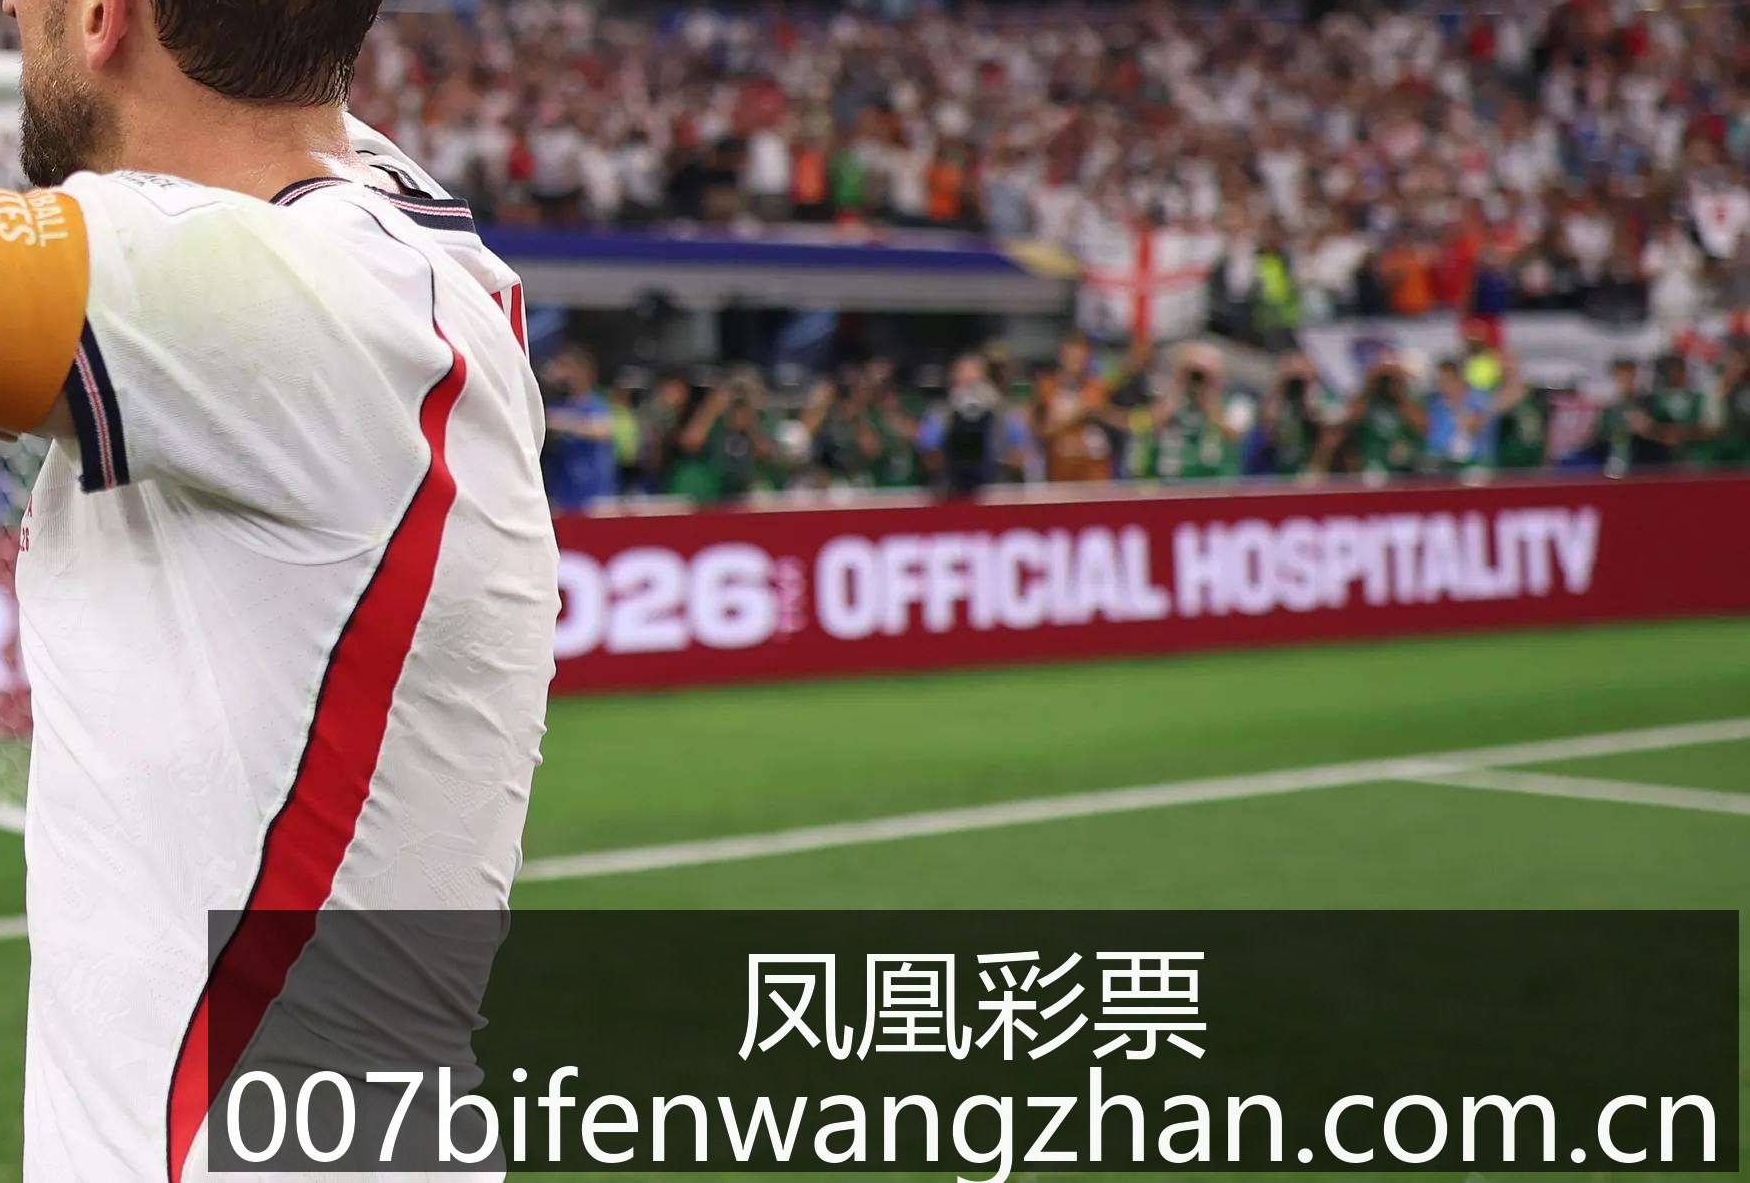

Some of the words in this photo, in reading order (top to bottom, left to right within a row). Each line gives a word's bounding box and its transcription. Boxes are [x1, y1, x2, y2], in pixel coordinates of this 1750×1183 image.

[552, 542, 778, 659] 026
[815, 524, 1171, 640] OFFICIAL
[1173, 505, 1603, 618] HOSPITALITY
